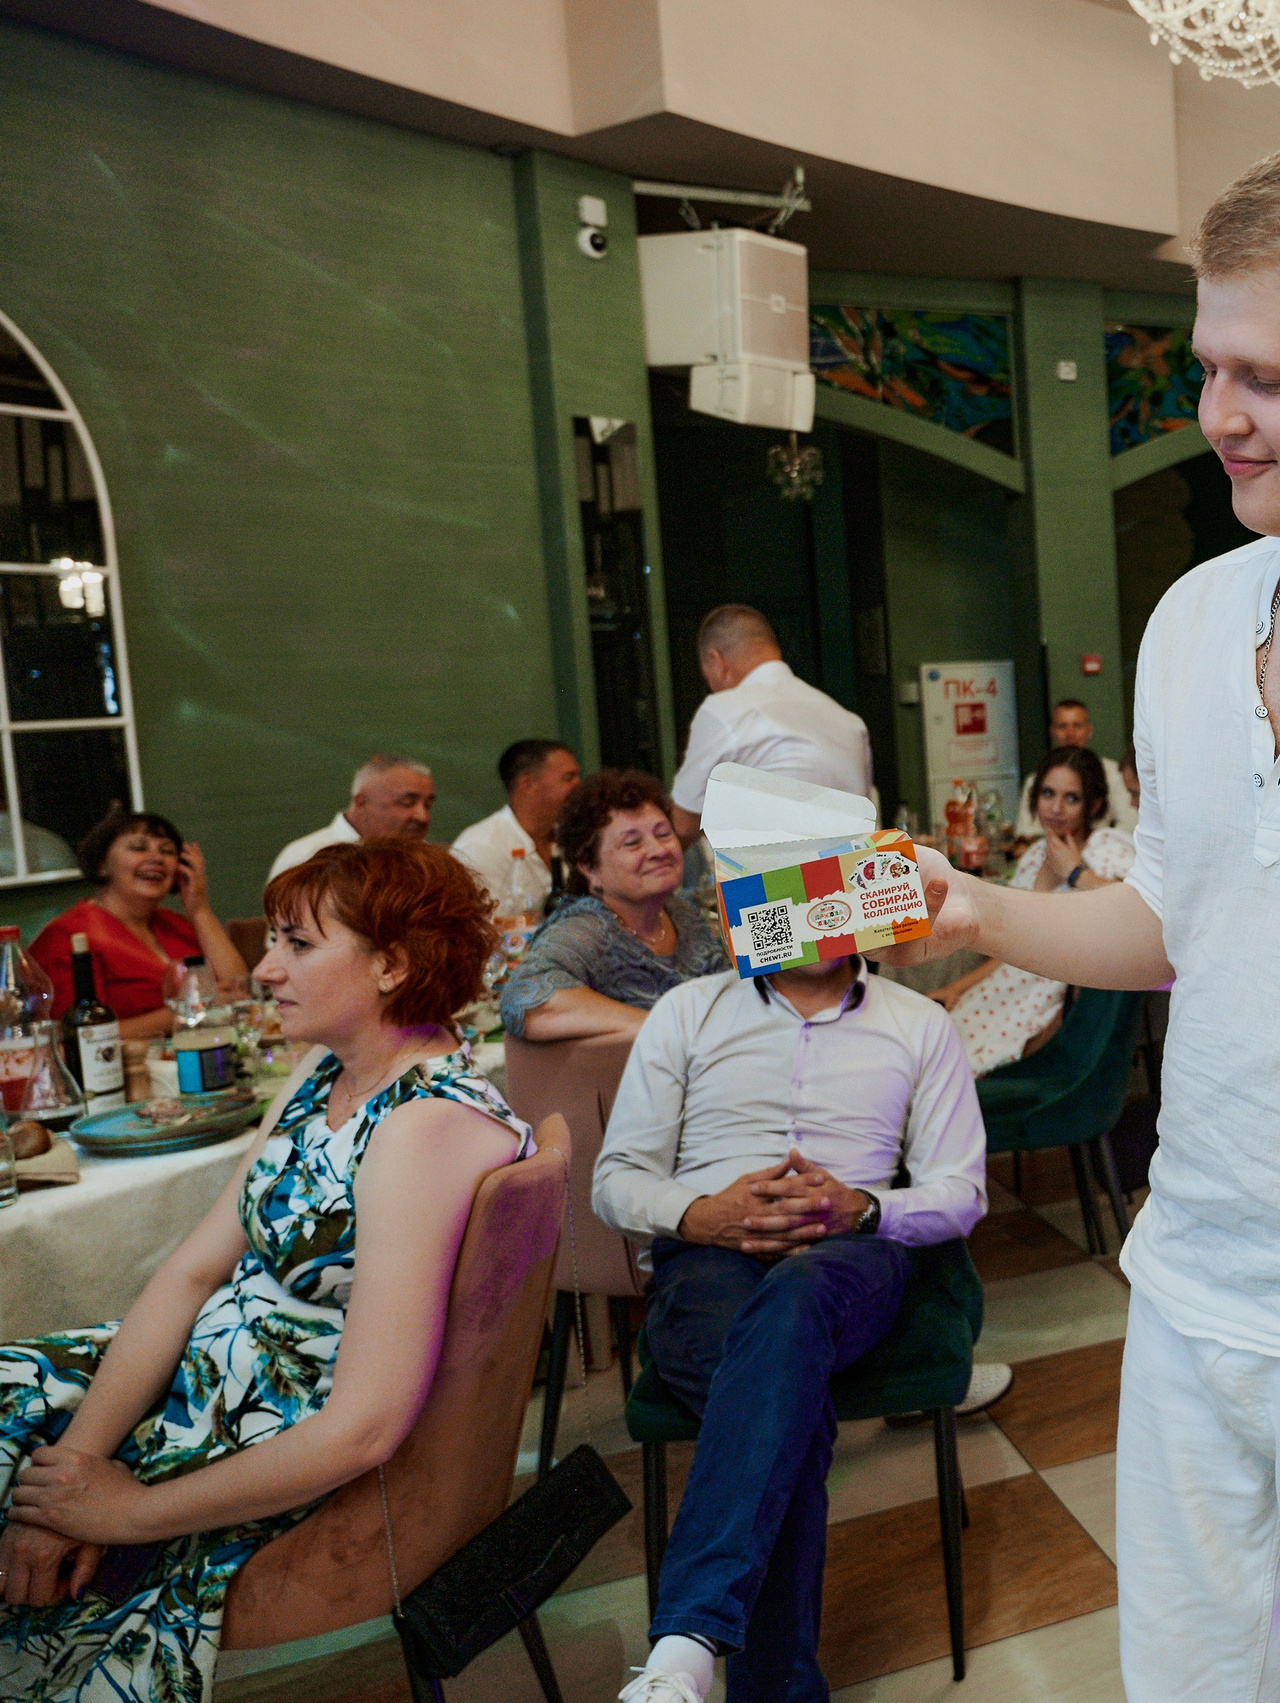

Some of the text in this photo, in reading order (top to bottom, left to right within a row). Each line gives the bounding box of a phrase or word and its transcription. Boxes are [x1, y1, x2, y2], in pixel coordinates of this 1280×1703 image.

[944, 678, 998, 700] ПК-4
[860, 882, 910, 900] СКАНИРУЙ
[862, 889, 918, 910] СОБИРАЙ
[863, 901, 923, 919] КОЛЛЕКЦИЮ
[756, 945, 793, 957] ПОДРОБНОСТИ
[760, 952, 792, 963] CHEWI.RU
